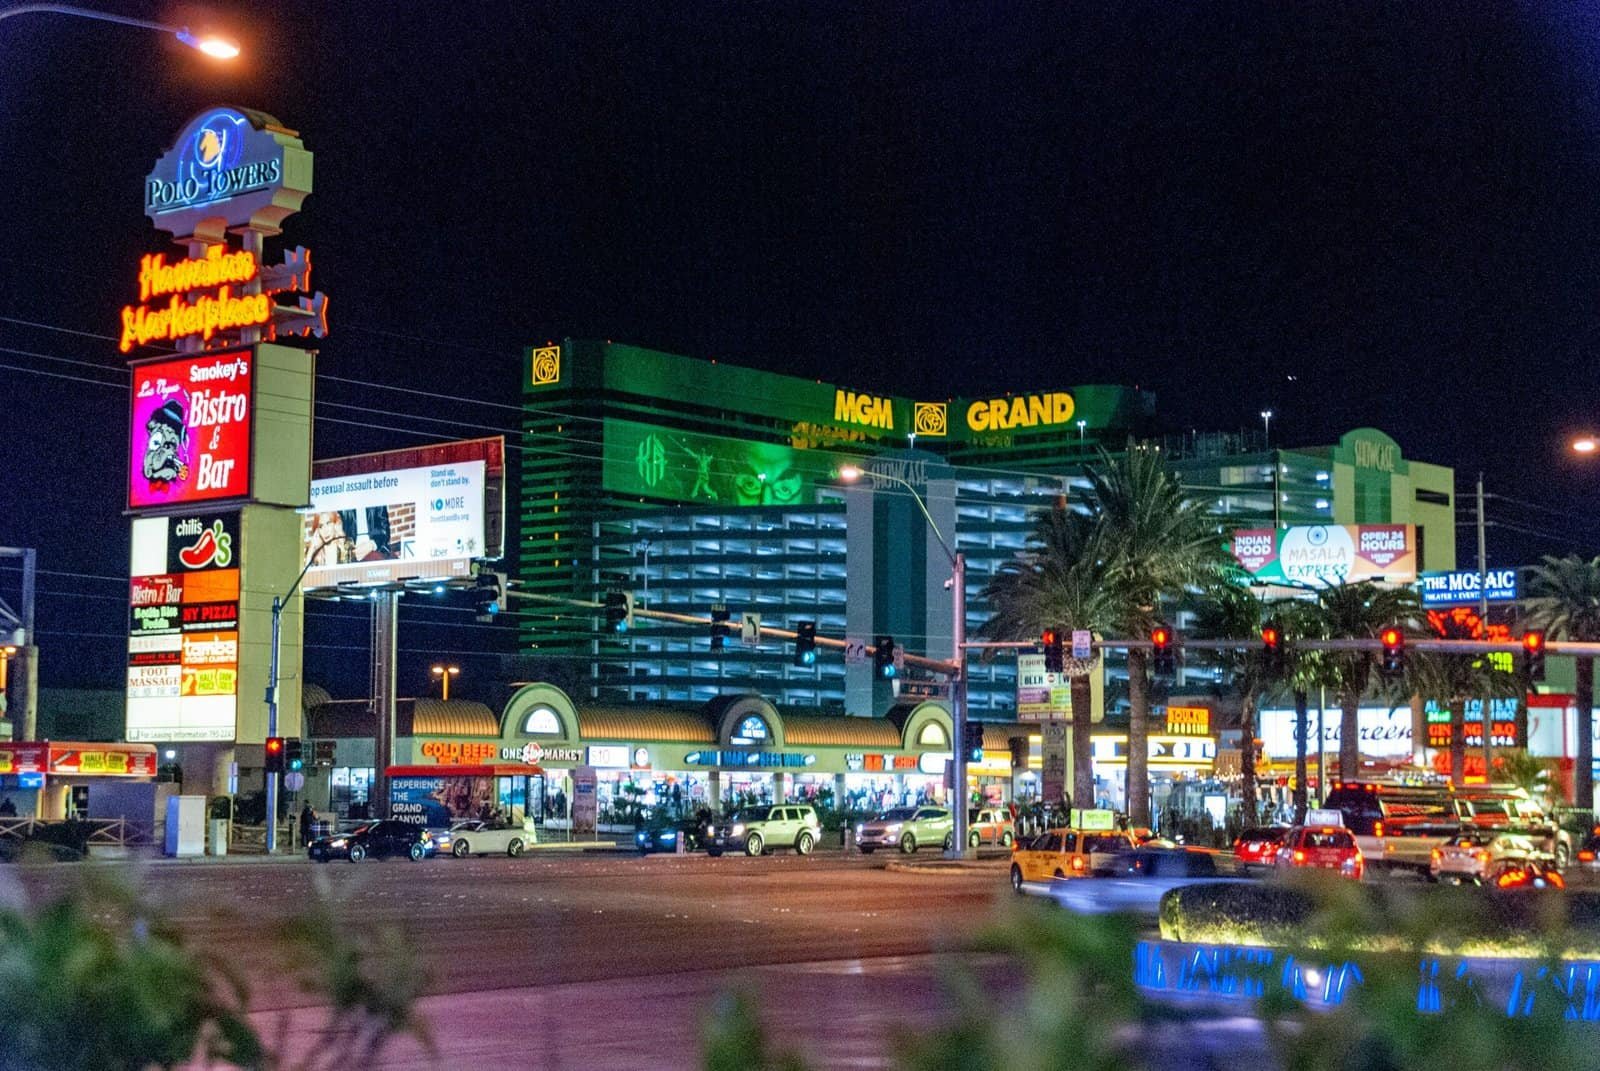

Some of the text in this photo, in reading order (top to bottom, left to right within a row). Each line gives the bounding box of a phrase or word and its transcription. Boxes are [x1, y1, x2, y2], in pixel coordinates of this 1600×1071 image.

[203, 159, 280, 195] TOWERS
[190, 358, 248, 382] Smokey's
[188, 389, 247, 428] Bistro
[834, 389, 1076, 432] MGM GRAND
[209, 426, 221, 450] &
[1355, 439, 1395, 472] SHOWCASE
[196, 453, 234, 491] Bar
[872, 460, 929, 489] SHOWCASE
[321, 480, 345, 495] sexual
[346, 479, 373, 492] assault
[374, 476, 399, 490] before
[445, 496, 464, 510] MORE
[176, 517, 203, 536] chili's
[1235, 535, 1271, 546] INDIAN
[1360, 530, 1390, 541] OPEN
[1235, 545, 1271, 556] FOOD
[1360, 539, 1405, 551] HOURS
[1288, 547, 1346, 562] MASALA
[1288, 564, 1349, 578] EXPRESS
[1424, 571, 1515, 591] THE MOSAIC
[166, 583, 182, 603] Bar
[202, 605, 237, 620] PIZZA
[140, 667, 168, 677] FOOT
[130, 677, 178, 687] MASSAGE
[423, 743, 496, 759] COLD BEER
[500, 747, 523, 760] ONE
[544, 749, 583, 761] MARKET
[392, 780, 445, 789] EXPERIENCE
[393, 791, 409, 801] THE
[392, 803, 423, 813] GRAND
[392, 814, 428, 825] CANYON
